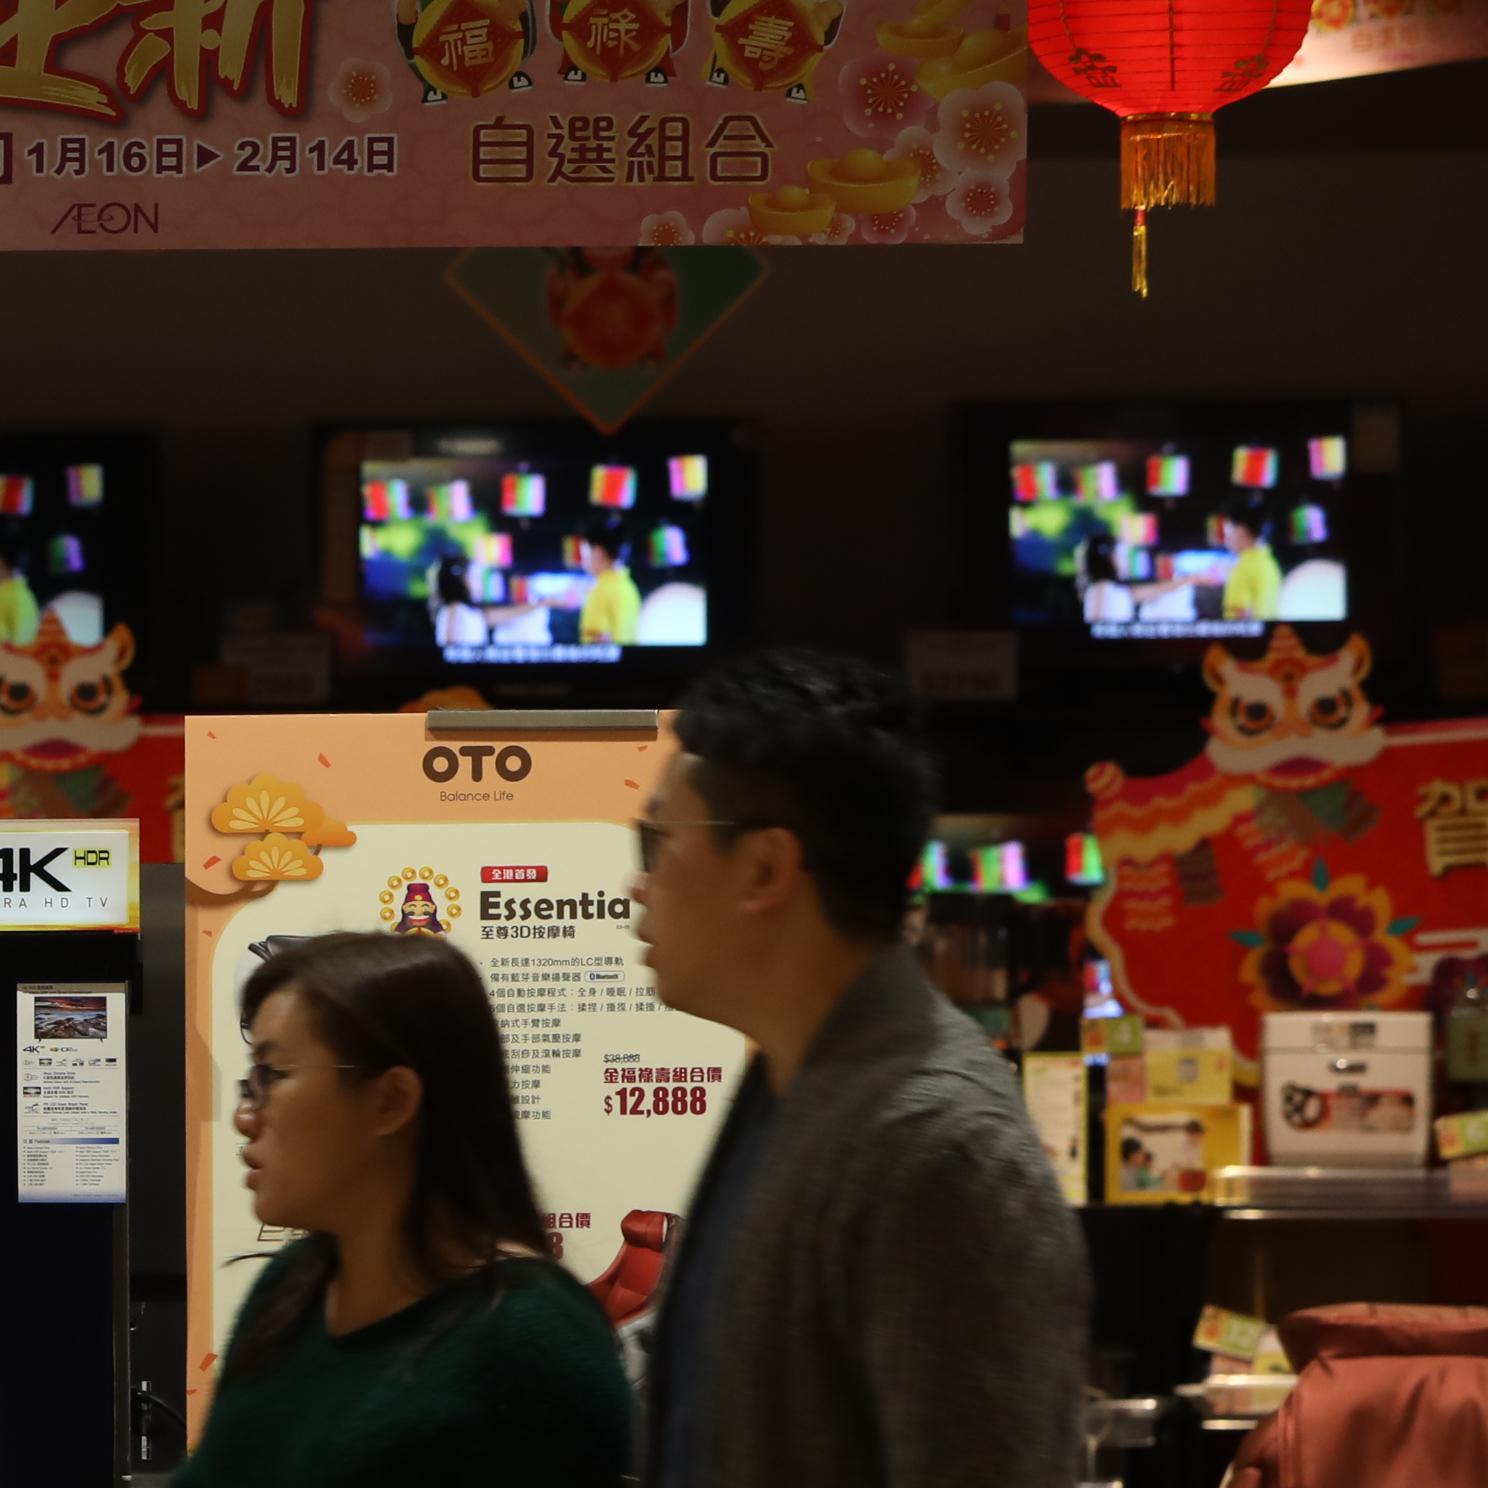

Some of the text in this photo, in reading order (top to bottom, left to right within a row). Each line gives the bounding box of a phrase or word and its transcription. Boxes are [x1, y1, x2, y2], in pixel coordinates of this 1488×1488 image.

[441, 19, 493, 71] 福
[739, 15, 797, 69] 壽
[25, 135, 187, 177] 1月16日
[233, 133, 398, 175] 2月14日
[472, 114, 776, 186] 自選組合
[422, 745, 532, 784] OTO
[439, 790, 514, 802] Balance Life
[74, 848, 111, 868] HDR
[491, 869, 537, 880] 全港首發
[44, 896, 68, 909] HD
[86, 896, 109, 909] TV
[480, 890, 631, 921] Essentia
[481, 925, 576, 940] 至尊3D按摩椅
[603, 1066, 723, 1084] 金福祿壽組合價
[603, 1087, 707, 1118] $12,888
